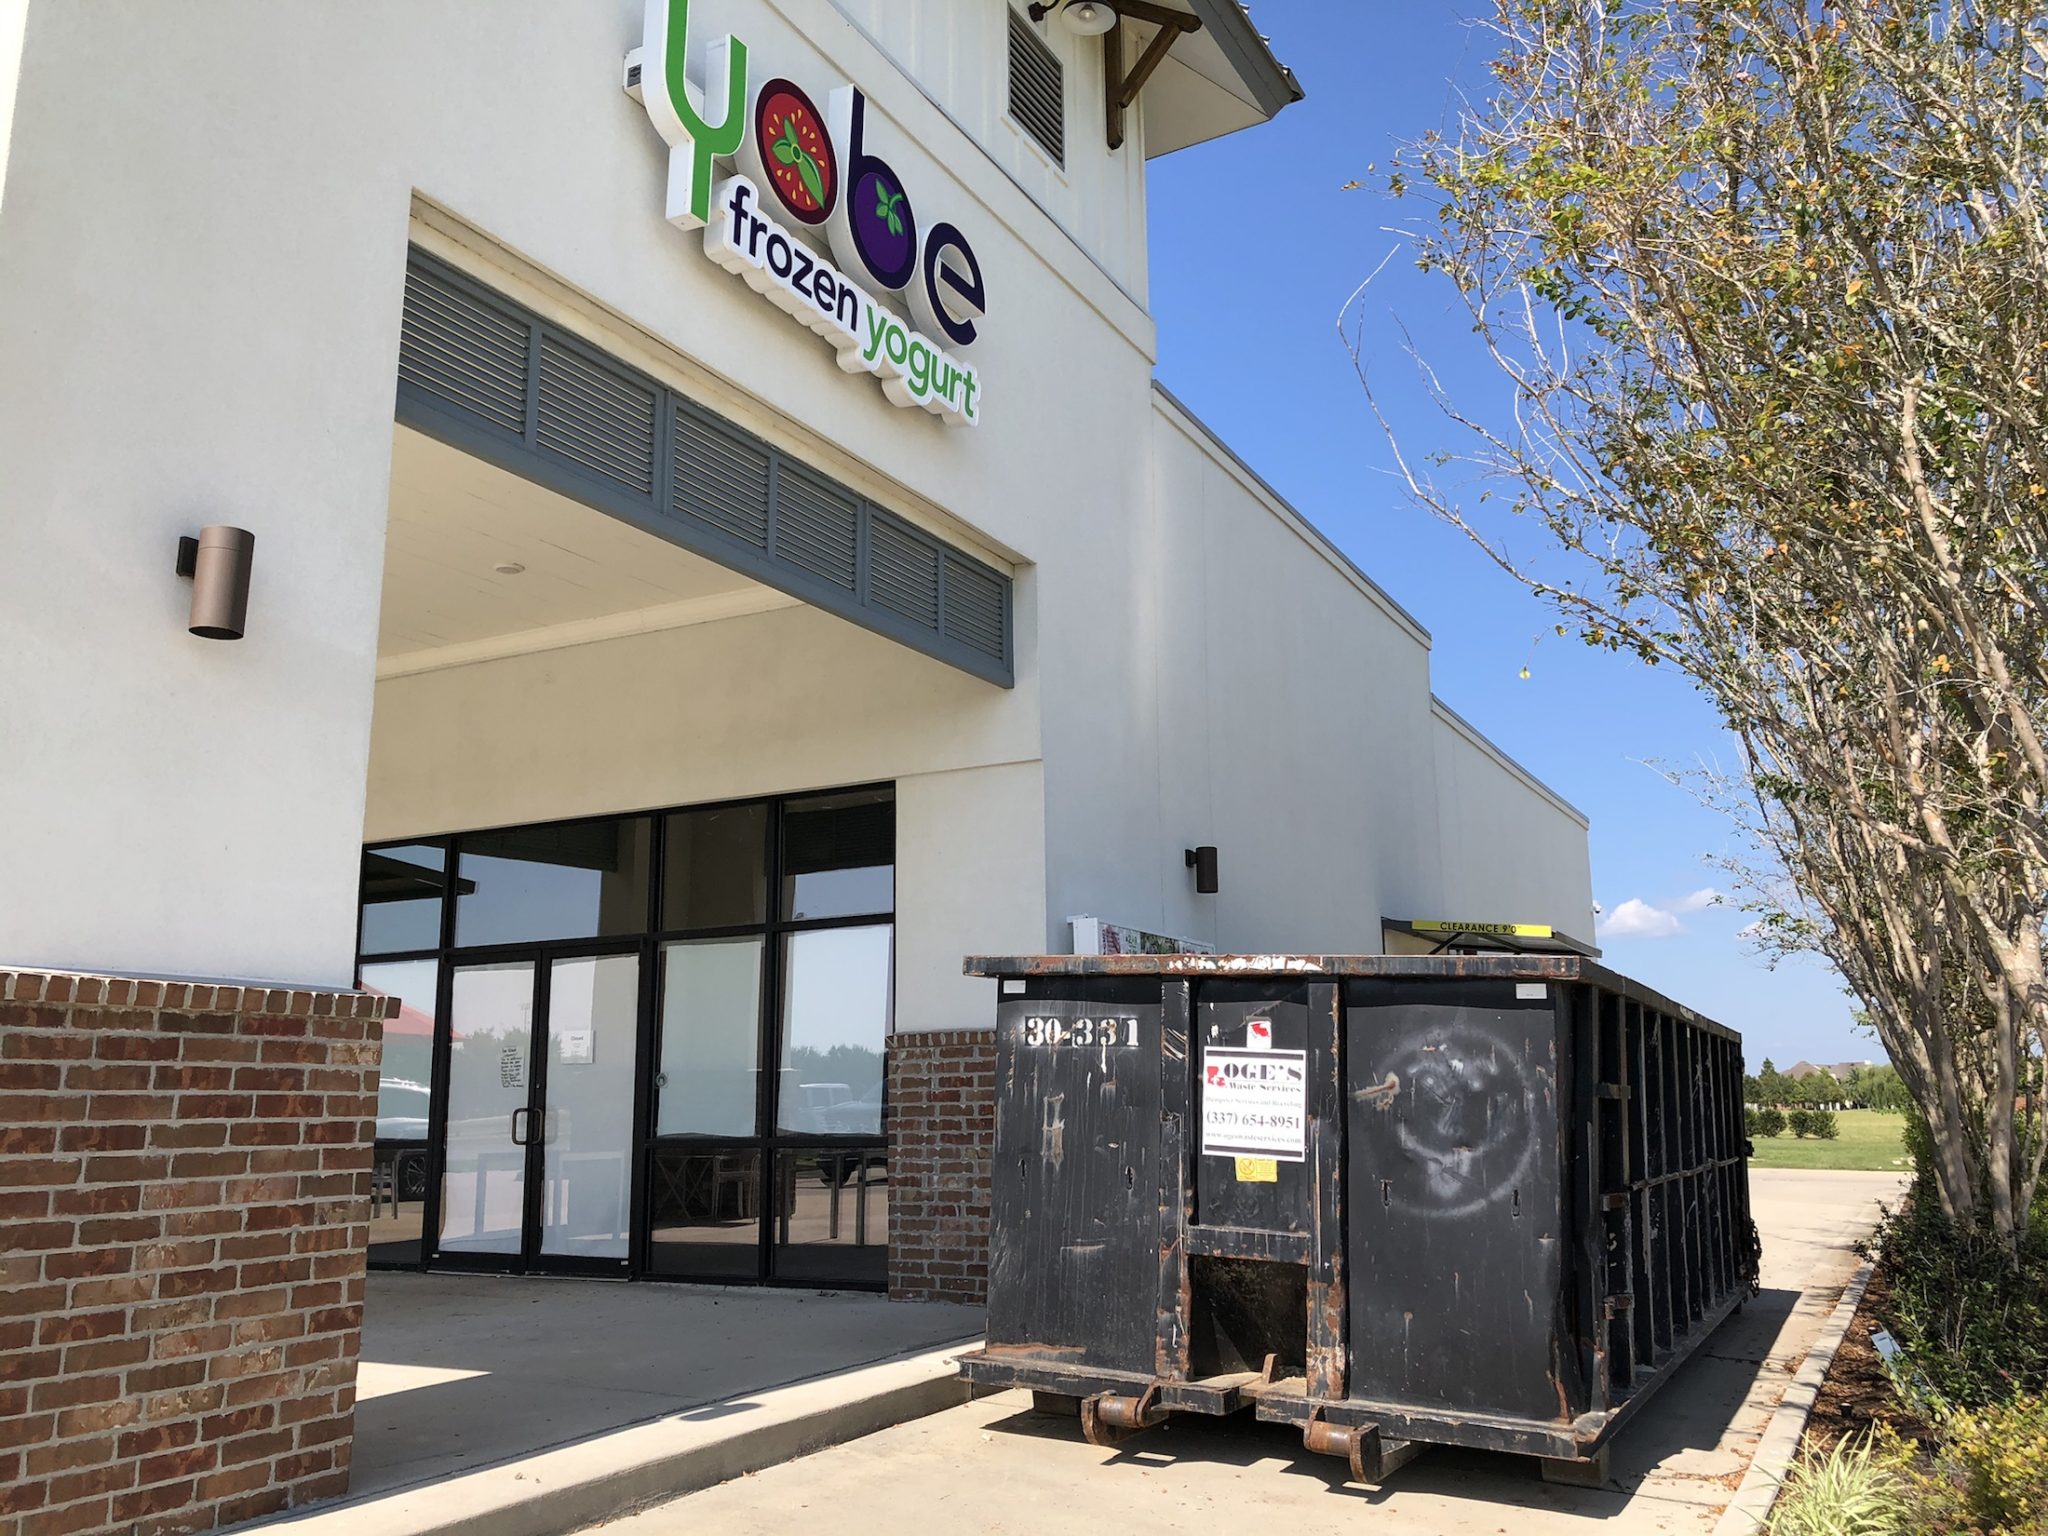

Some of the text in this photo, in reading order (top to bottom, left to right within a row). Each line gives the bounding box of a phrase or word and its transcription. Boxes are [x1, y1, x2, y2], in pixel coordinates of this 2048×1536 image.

[663, 0, 986, 346] yobe
[729, 184, 976, 418] frozen yogurt
[1440, 921, 1499, 933] CLEARANCE
[1026, 1017, 1140, 1046] 30-331
[1229, 1082, 1302, 1093] Waste Services
[1206, 1111, 1300, 1129] (337) 654-8951
